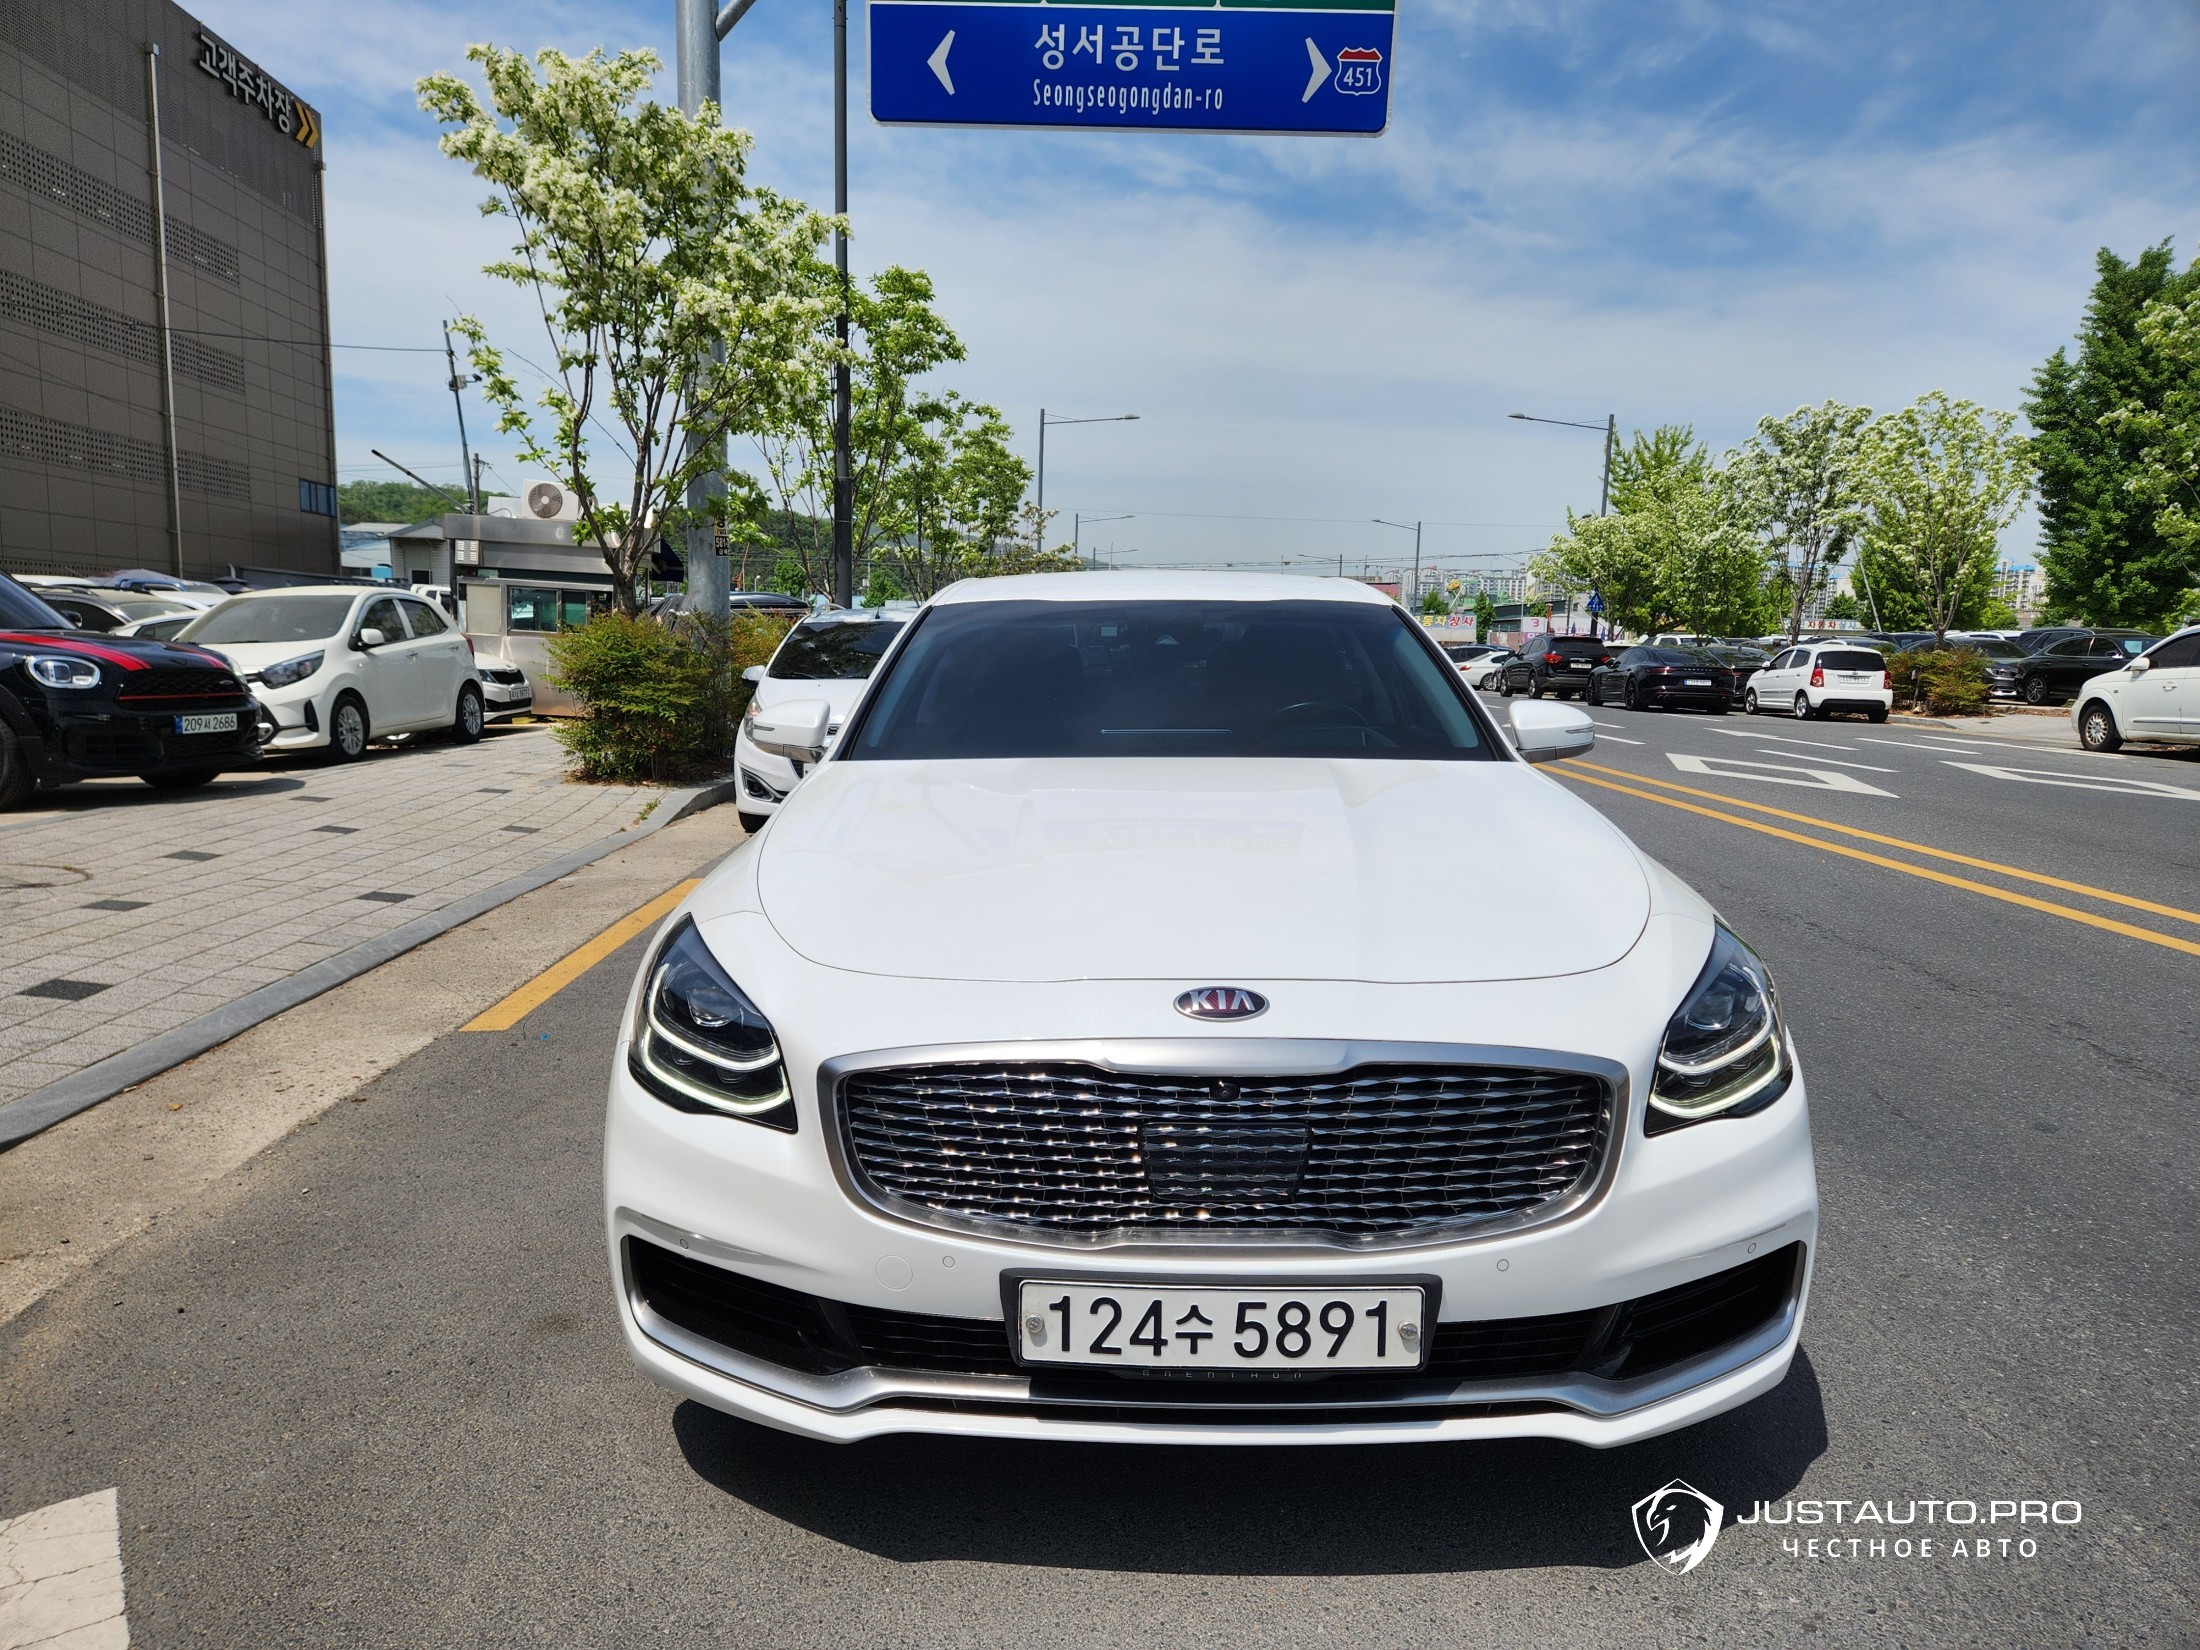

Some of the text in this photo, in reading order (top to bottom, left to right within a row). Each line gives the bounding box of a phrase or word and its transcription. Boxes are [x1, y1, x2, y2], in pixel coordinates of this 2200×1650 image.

[1033, 23, 1225, 72] 성서공단로
[199, 33, 292, 134] 고객주차장
[1343, 66, 1373, 88] 451
[1032, 78, 1224, 116] Seongseogongdan-ro
[1449, 615, 1475, 627] 상사
[1807, 620, 1837, 629] 자동차
[213, 716, 235, 729] 2686
[1189, 989, 1256, 1011] KIA
[1233, 1300, 1388, 1359] 5891
